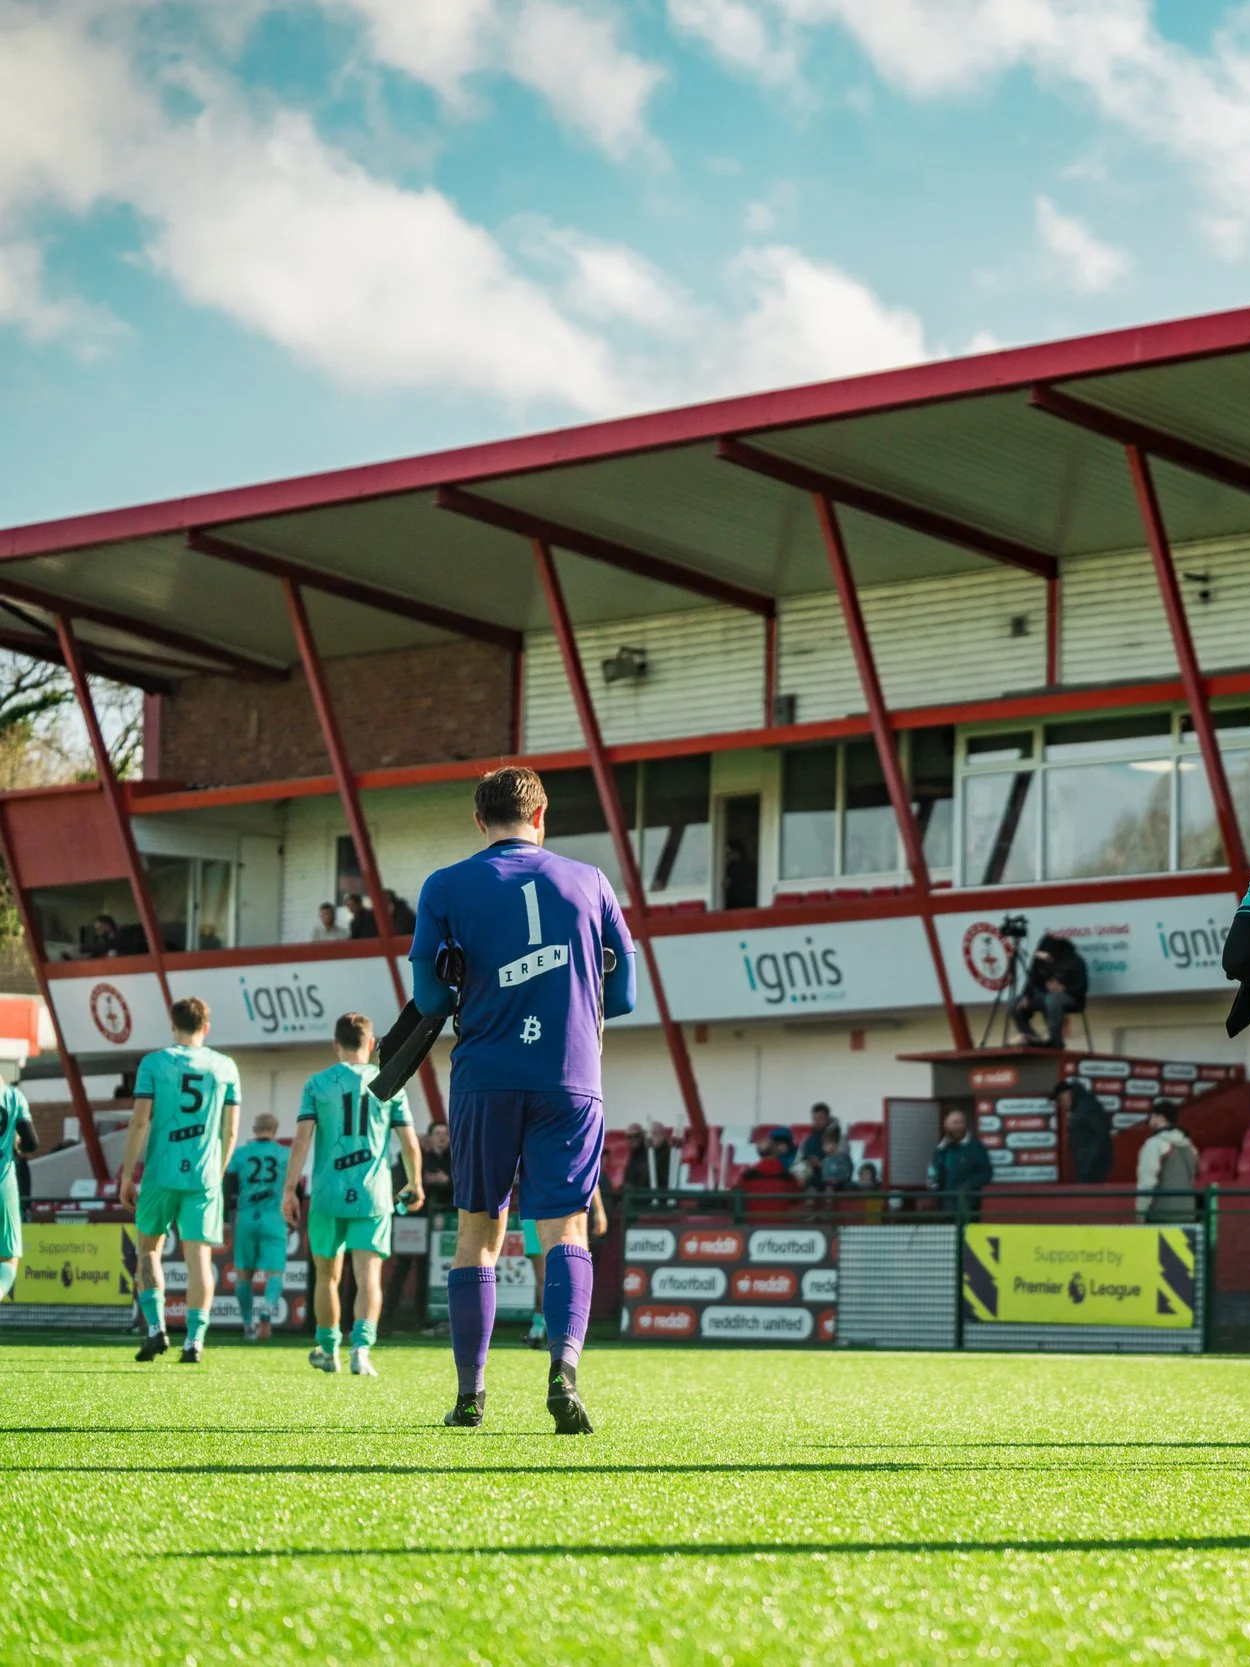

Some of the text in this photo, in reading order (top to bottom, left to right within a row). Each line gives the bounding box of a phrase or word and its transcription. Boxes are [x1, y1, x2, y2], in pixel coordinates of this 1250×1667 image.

[520, 880, 543, 945] 1
[504, 949, 562, 983] IREN
[739, 936, 843, 1005] ignis
[239, 973, 325, 1034] ignis
[180, 1073, 204, 1114] 5
[342, 1091, 369, 1136] 11
[247, 1155, 278, 1185] 23
[24, 1264, 110, 1284] Premier League
[1034, 1245, 1123, 1267] Supported by
[1013, 1275, 1141, 1301] Premier League
